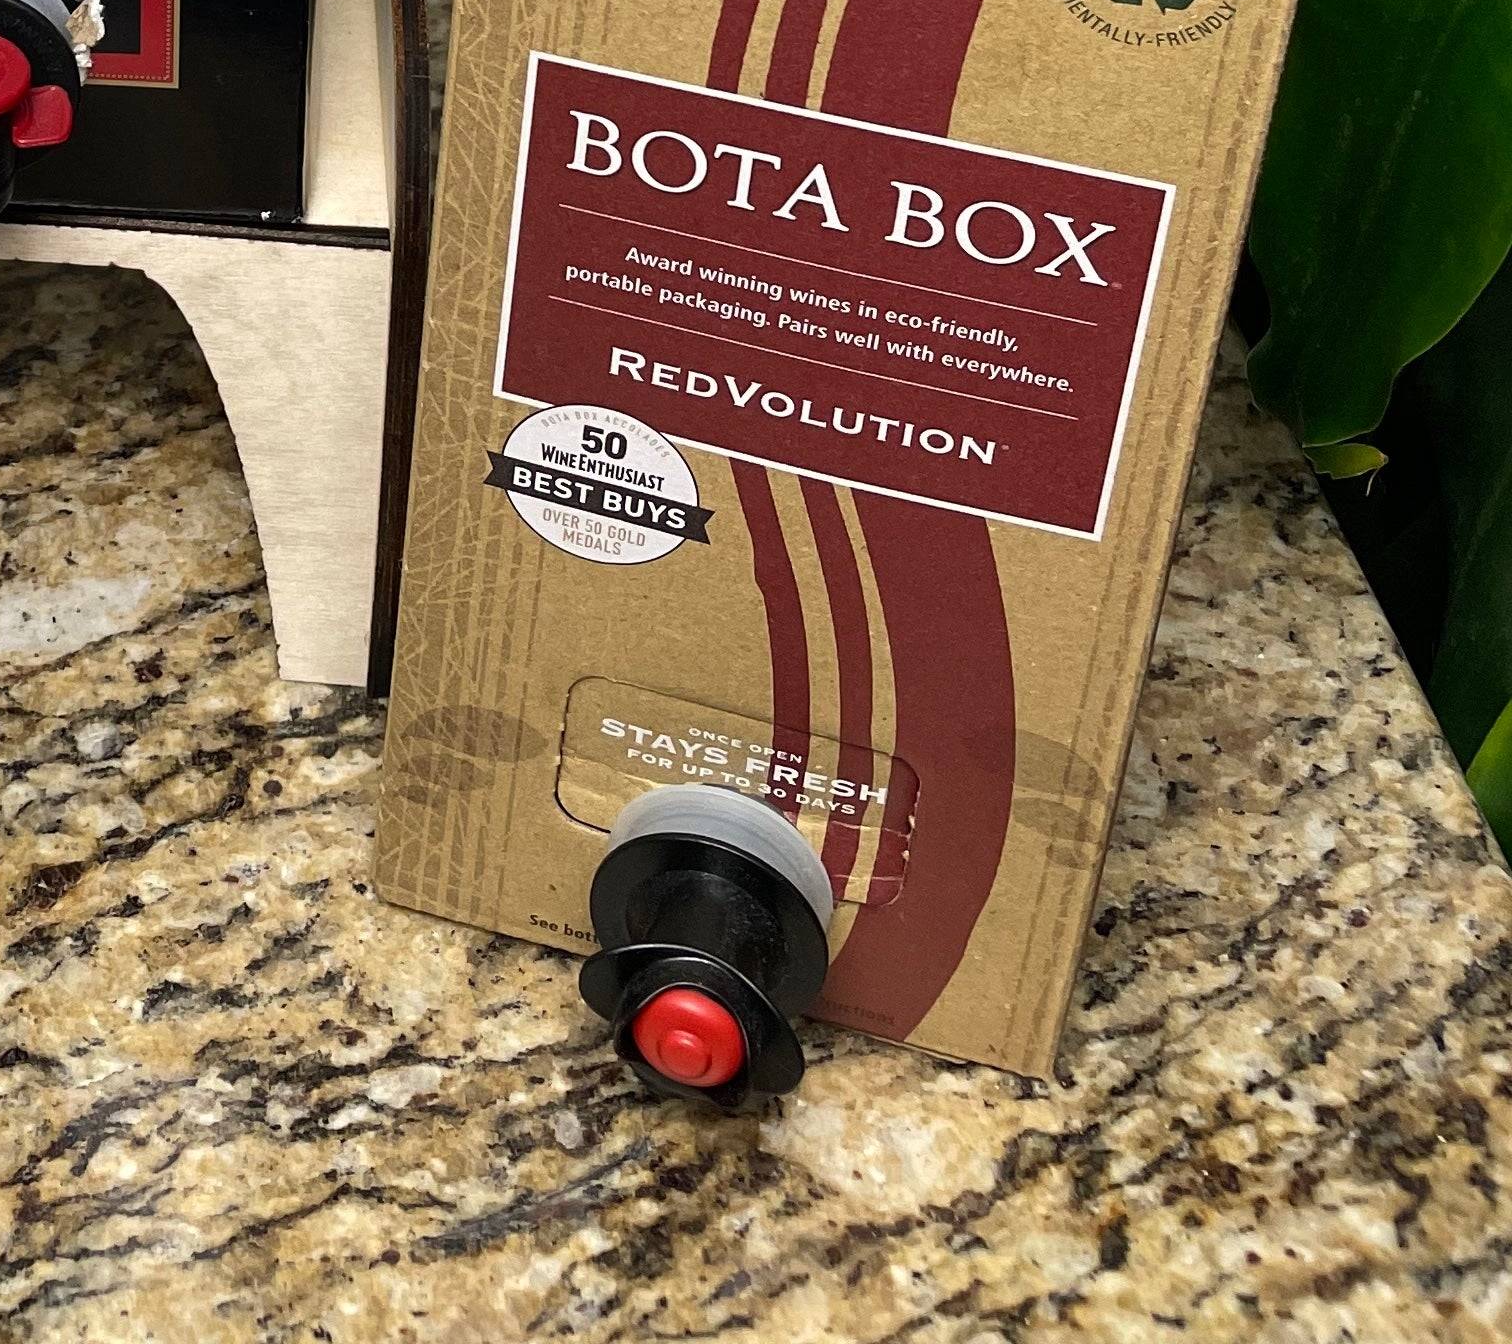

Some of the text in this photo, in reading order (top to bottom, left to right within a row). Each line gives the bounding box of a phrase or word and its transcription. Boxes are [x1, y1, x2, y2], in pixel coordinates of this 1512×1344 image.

[566, 110, 1116, 287] BOTA BOX
[565, 265, 1074, 393] portable packaging. Pairs well with everywhere.
[625, 246, 1019, 352] Award winning wines in eco-friendly,
[581, 424, 627, 460] 50
[512, 465, 686, 530] BEST BUYS
[543, 507, 646, 547] OVER 50 GOLD
[562, 528, 622, 556] MEDALS
[600, 717, 890, 805] STAYS FRESH
[688, 726, 803, 764] ONCE OPEN
[626, 747, 856, 816] FOR UP TO 30 DAYS
[529, 914, 559, 932] See
